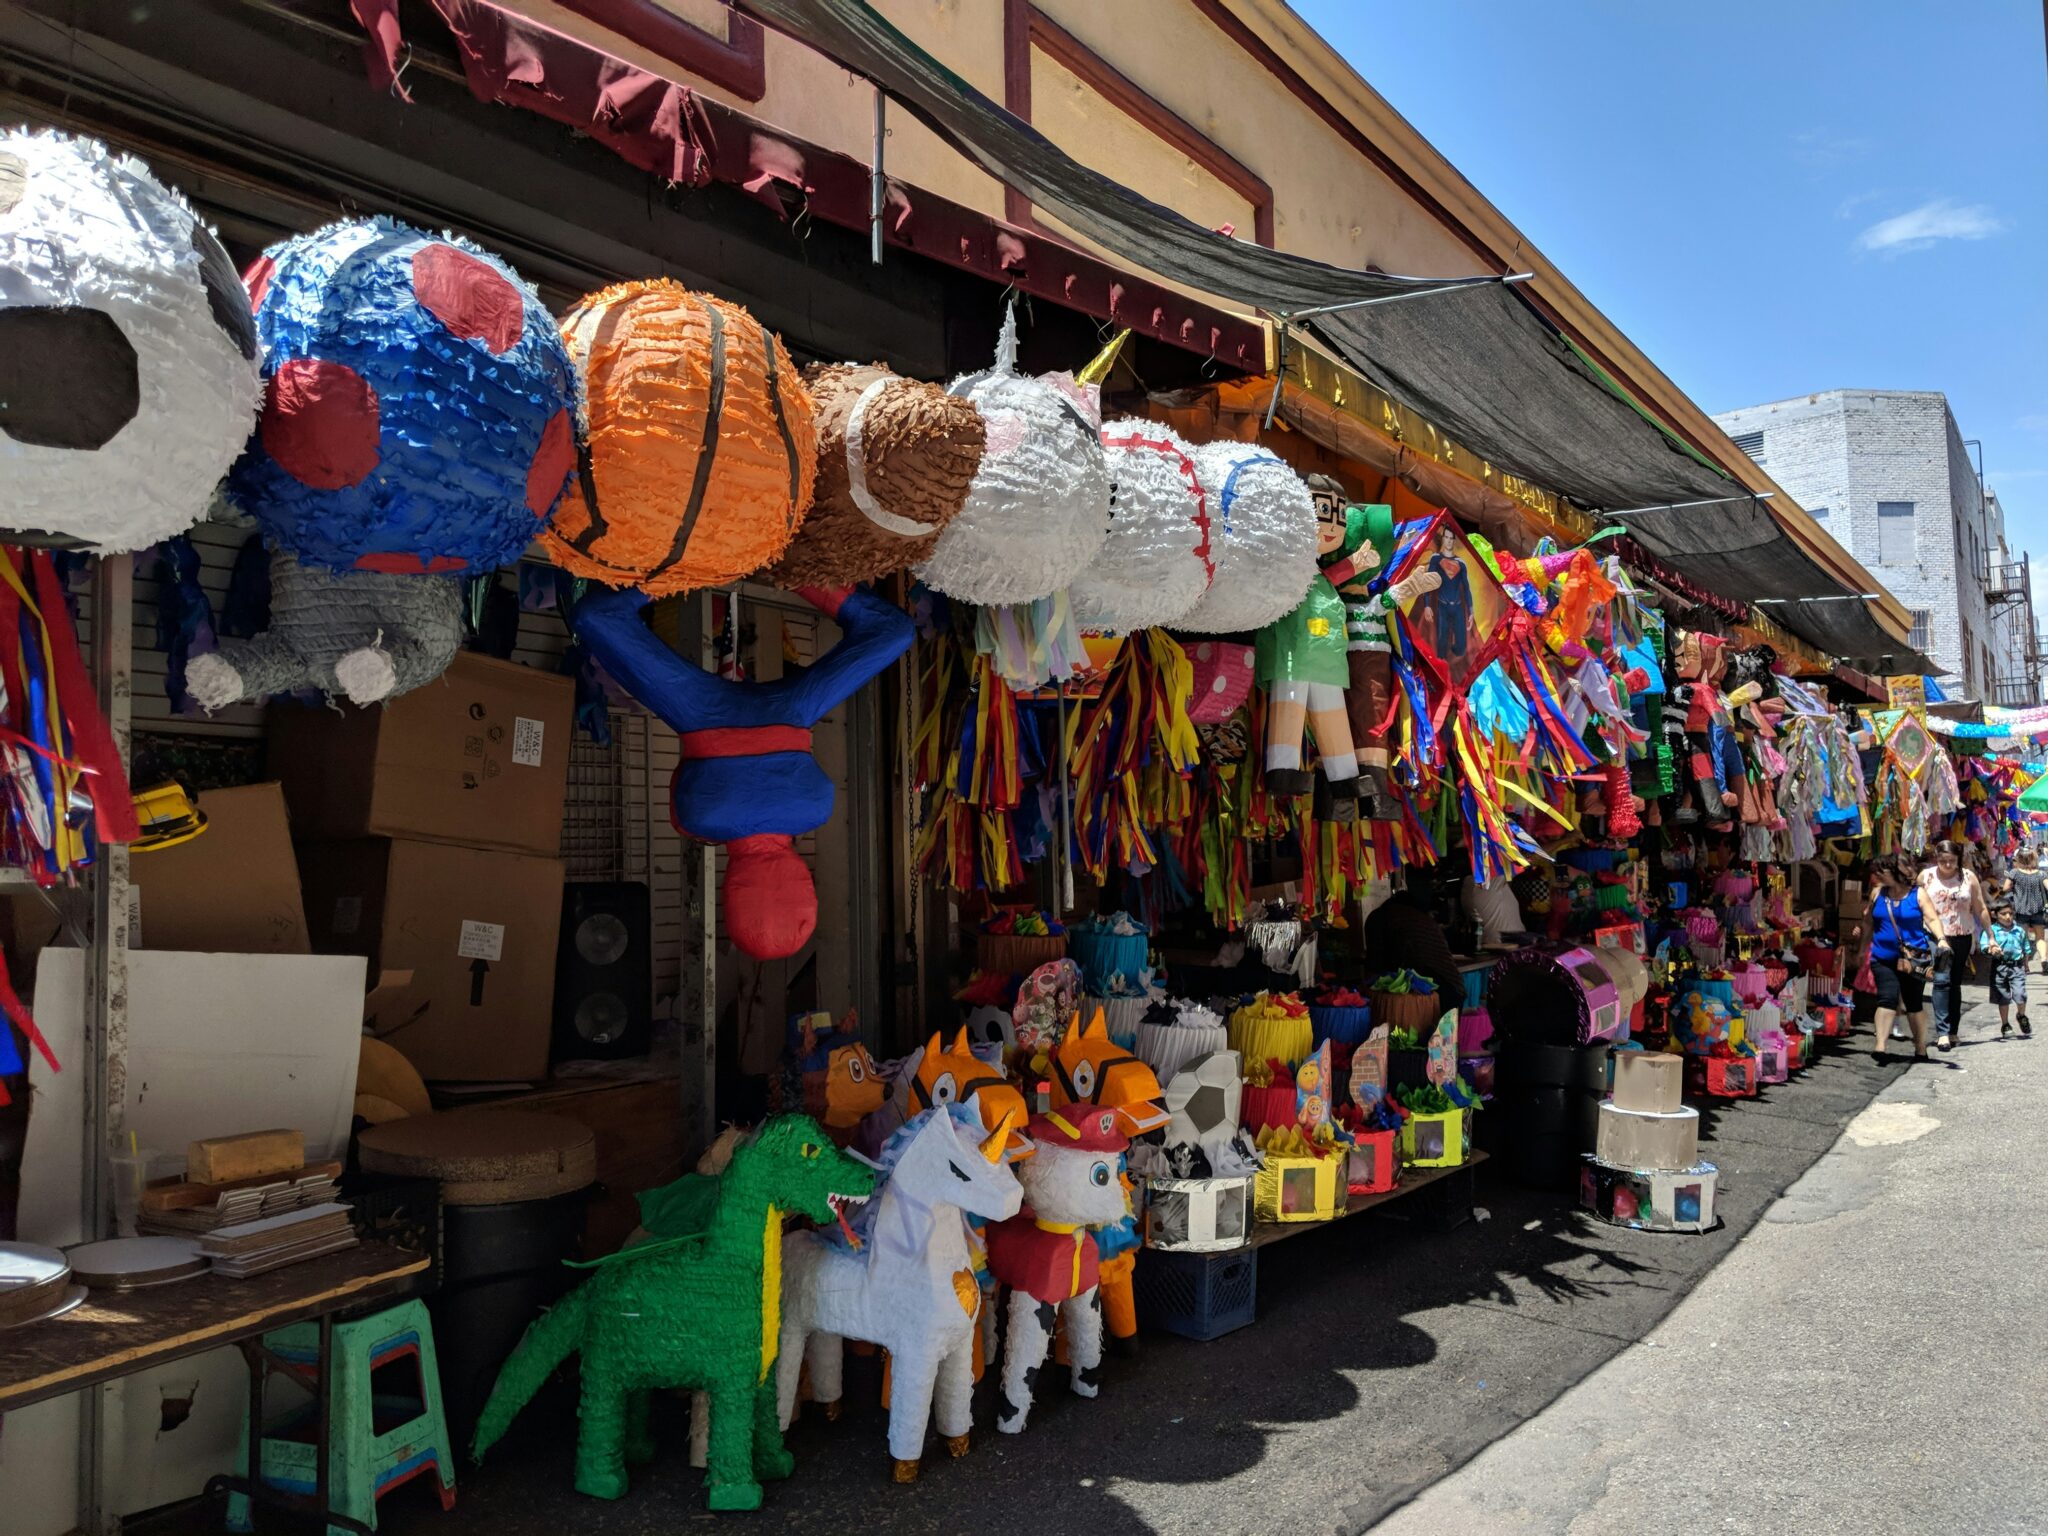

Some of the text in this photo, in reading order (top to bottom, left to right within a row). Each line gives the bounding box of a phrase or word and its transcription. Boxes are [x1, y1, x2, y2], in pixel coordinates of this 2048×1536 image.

[532, 731, 541, 756] W&C
[129, 902, 139, 931] W&C
[474, 925, 494, 934] W&C
